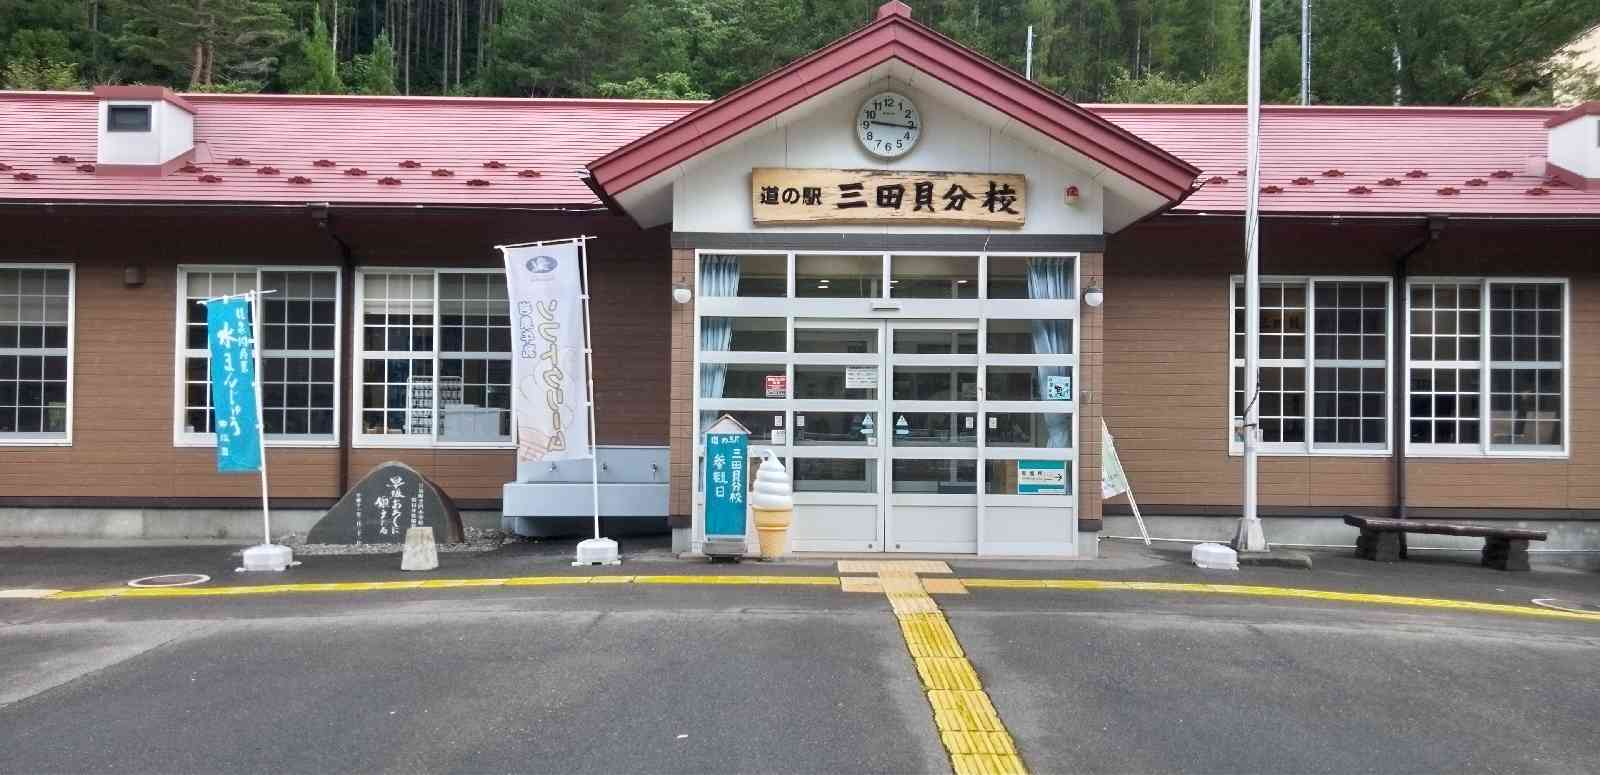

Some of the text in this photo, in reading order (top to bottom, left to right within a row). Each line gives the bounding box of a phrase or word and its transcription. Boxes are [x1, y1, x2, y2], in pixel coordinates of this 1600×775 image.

[873, 101, 882, 111] 11
[884, 98, 896, 107] 12
[898, 102, 903, 111] 1
[864, 110, 876, 119] 10
[904, 109, 912, 118] 2
[863, 120, 870, 129] 9
[907, 120, 914, 129] 3
[866, 131, 873, 140] 8
[904, 131, 910, 140] 4
[874, 139, 882, 149] 7
[885, 142, 892, 151] 6
[896, 139, 903, 148] 5
[760, 181, 1019, 215] 道の駅 三田貝分校
[217, 321, 241, 437] 水まんじゅう
[729, 448, 743, 504] 三田貝分校
